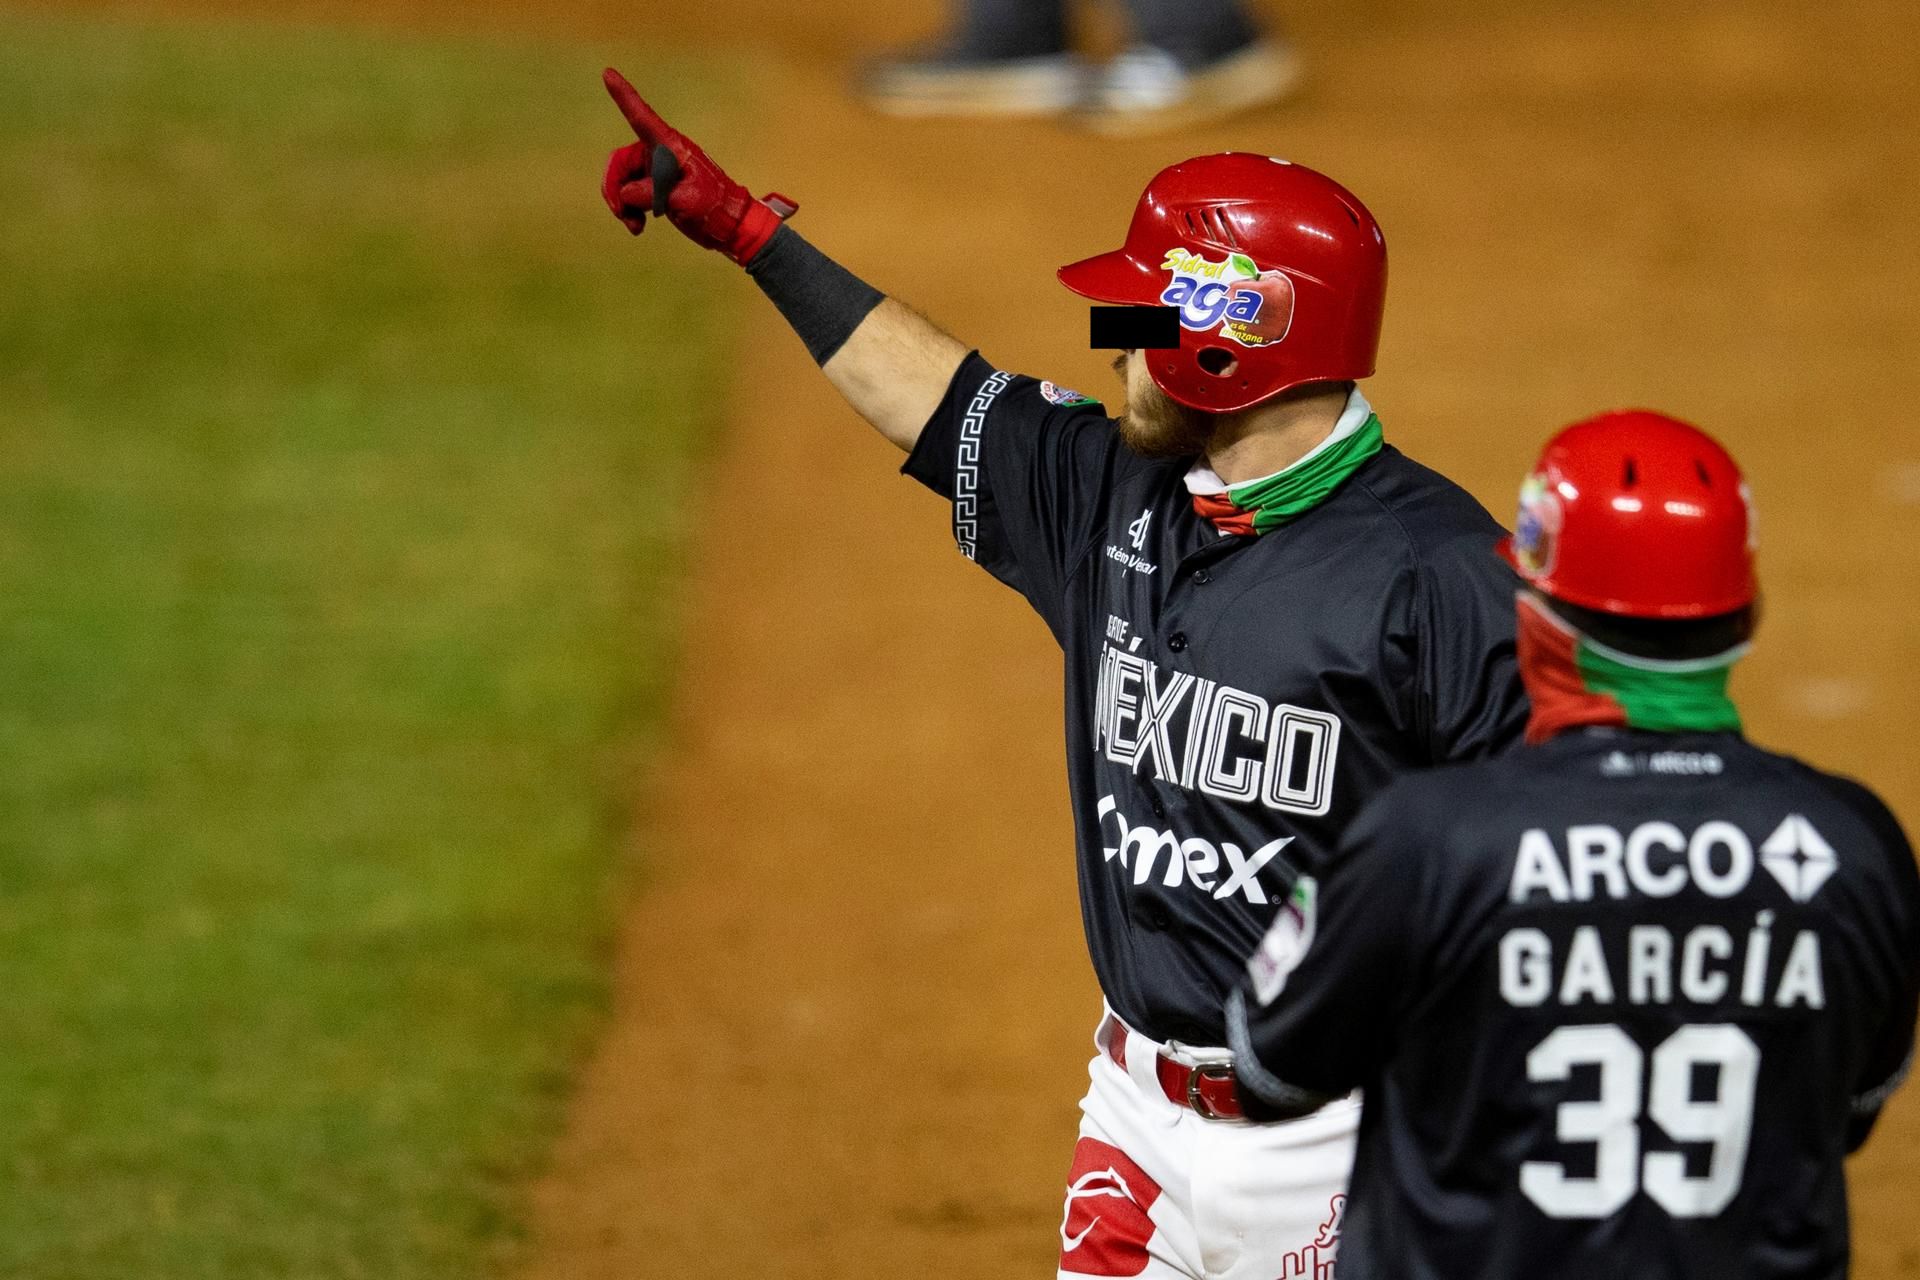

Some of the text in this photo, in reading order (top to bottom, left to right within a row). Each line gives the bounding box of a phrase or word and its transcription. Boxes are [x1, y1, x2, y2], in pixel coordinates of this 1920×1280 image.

[1160, 248, 1230, 280] Sidral
[1162, 276, 1264, 329] aga
[1221, 329, 1264, 343] manzana
[1509, 819, 1755, 903] ARCO
[1498, 910, 1824, 1008] GARCÍA
[1519, 1022, 1761, 1219] 39
